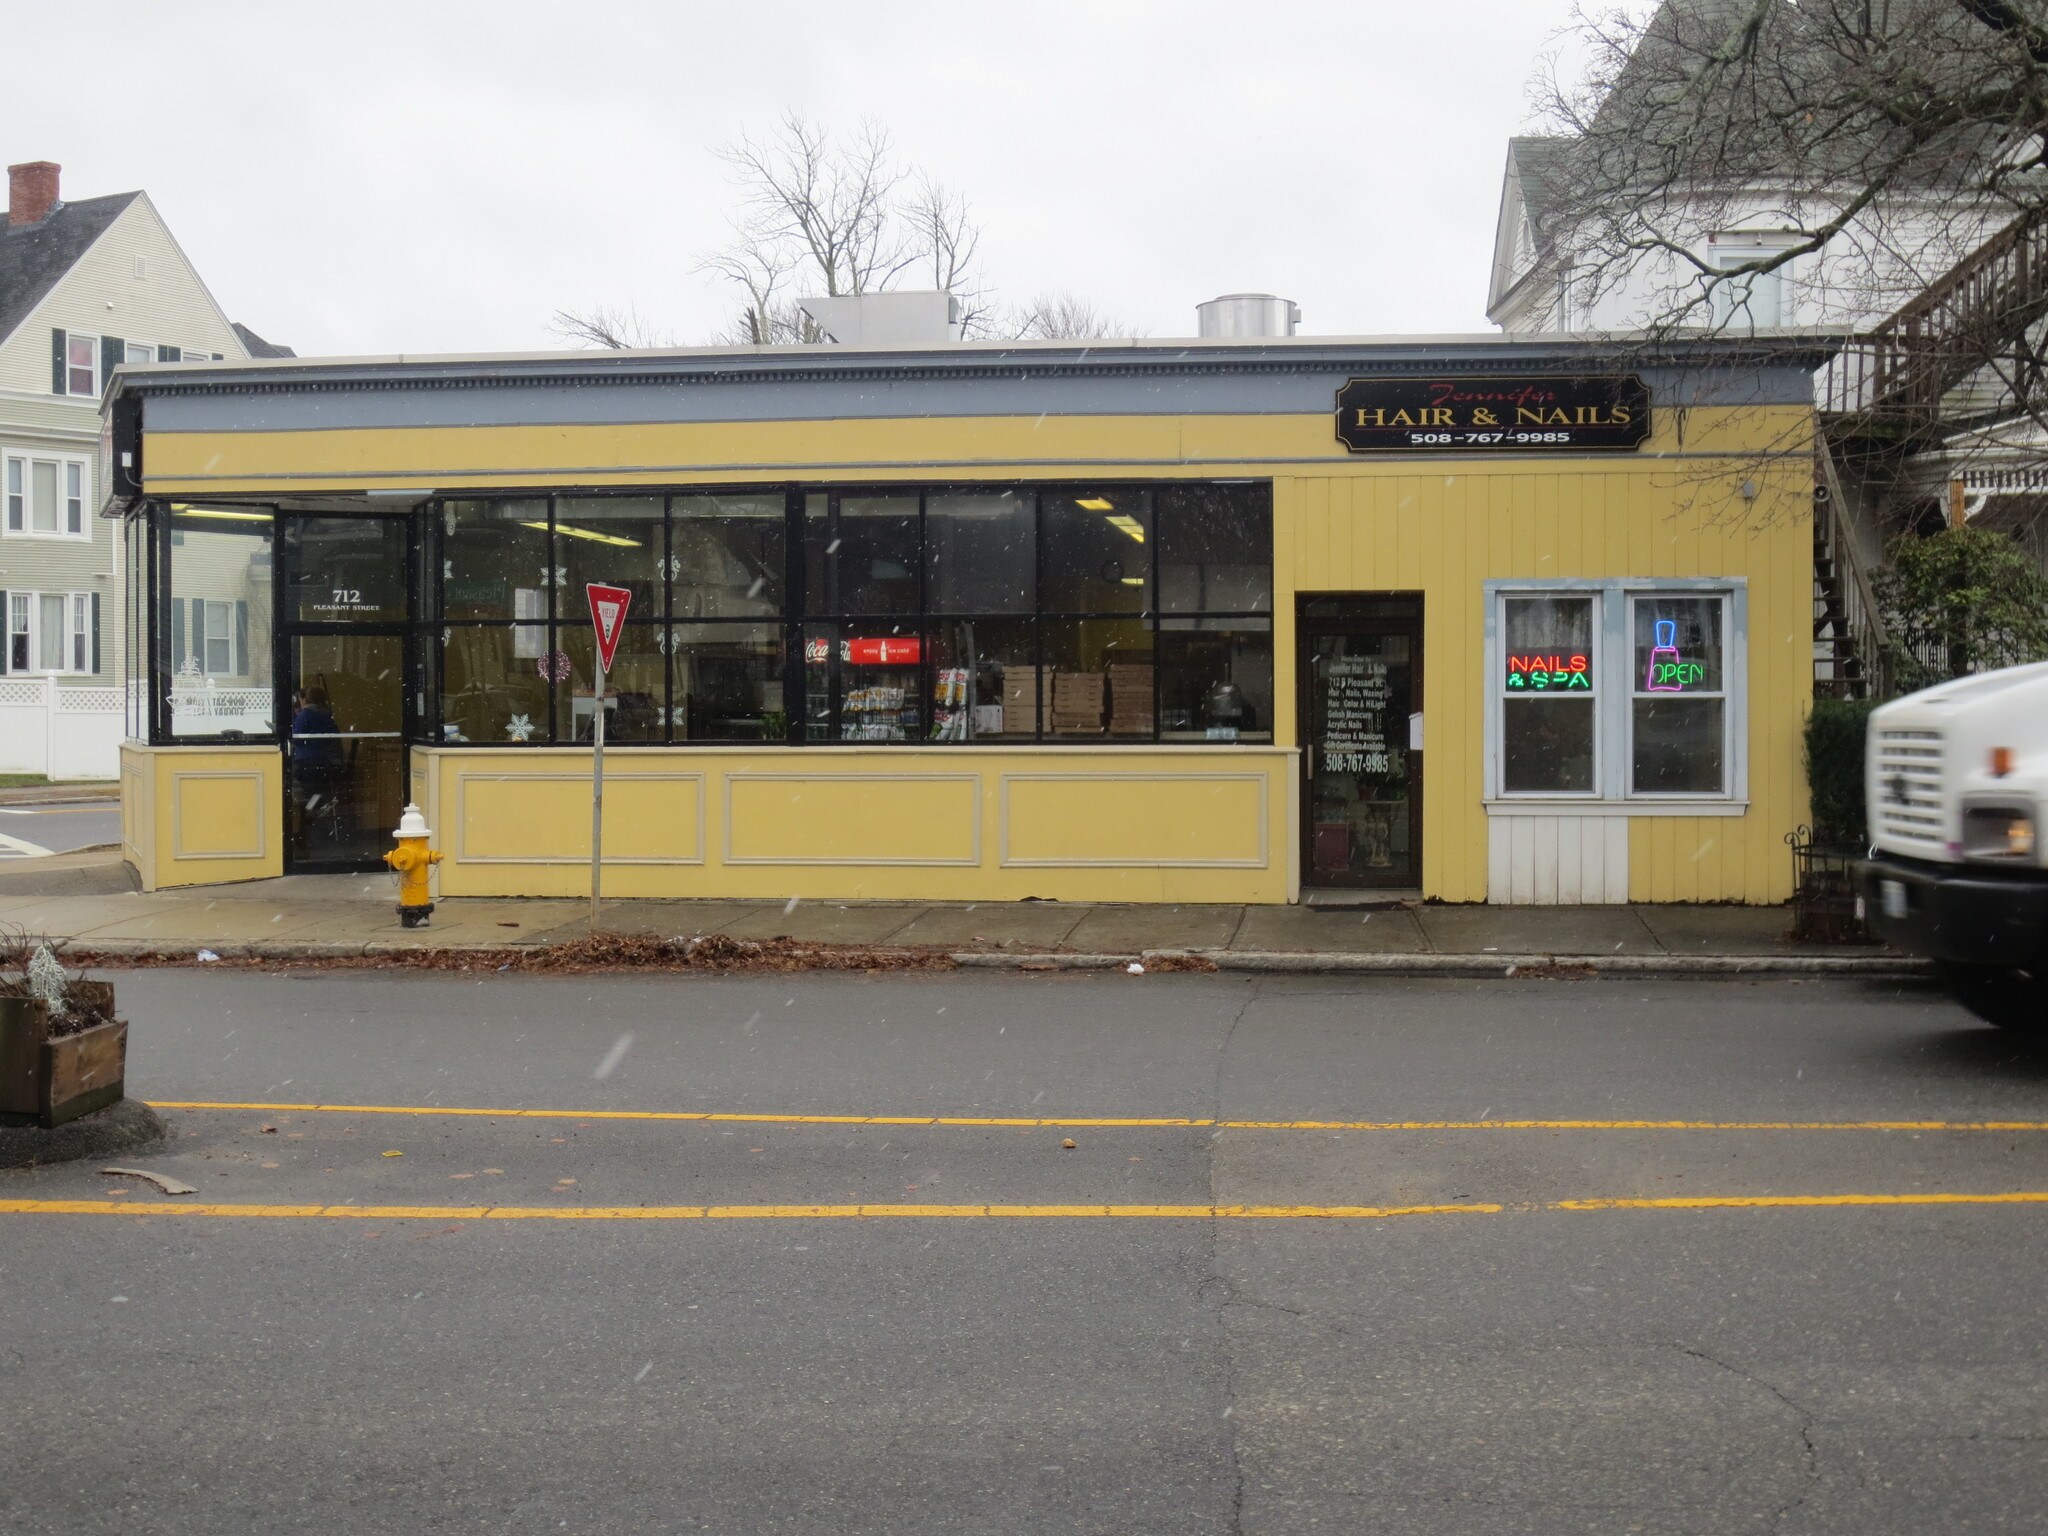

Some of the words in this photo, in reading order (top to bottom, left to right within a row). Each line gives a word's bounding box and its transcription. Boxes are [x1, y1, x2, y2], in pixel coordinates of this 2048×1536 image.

[1429, 383, 1556, 405] Jennifer
[1356, 408, 1456, 427] HAIR
[1472, 407, 1499, 425] &
[1515, 406, 1631, 425] NAILS
[1411, 432, 1570, 444] 508-767-9985
[332, 589, 361, 603] 712
[602, 607, 615, 619] YIELD
[1352, 663, 1364, 674] Hair
[1510, 655, 1587, 672] NAILS
[1509, 672, 1524, 688] &
[1531, 672, 1589, 688] SPA
[1652, 664, 1704, 684] OPEN
[1329, 677, 1340, 687] 712
[1347, 678, 1374, 687] Pleasant
[1363, 689, 1383, 699] Waxing
[1344, 699, 1359, 708] Color
[1327, 720, 1347, 730] Acrylic
[1348, 720, 1362, 729] Nails
[1327, 731, 1351, 740] Pedicure
[1358, 732, 1384, 740] Manicure
[1326, 753, 1389, 773] 508-767-9985
